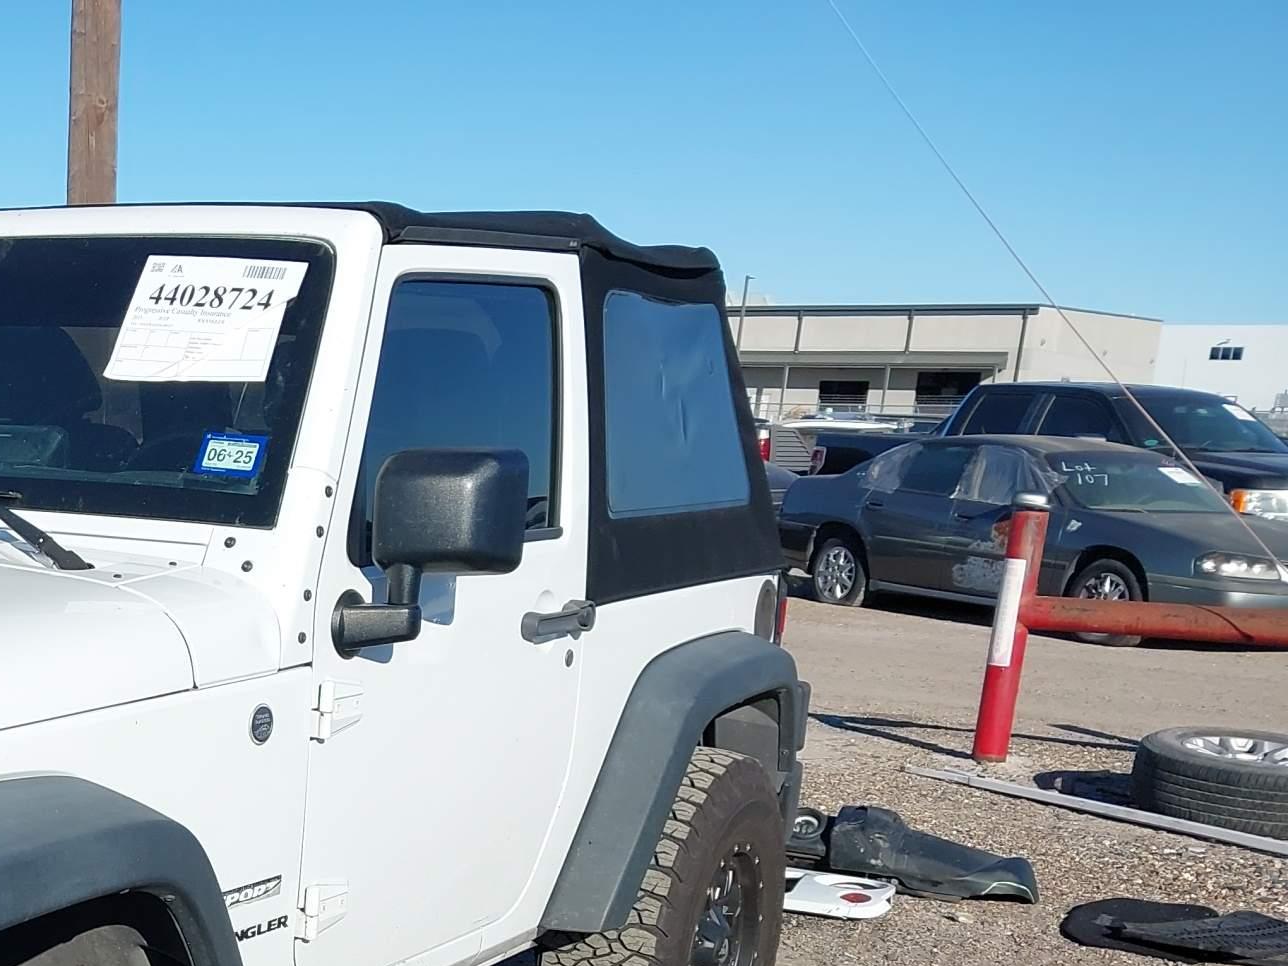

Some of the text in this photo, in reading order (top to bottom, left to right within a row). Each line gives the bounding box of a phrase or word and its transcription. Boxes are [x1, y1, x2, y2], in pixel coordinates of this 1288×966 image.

[149, 284, 275, 311] 44028724
[1061, 461, 1096, 472] Lot
[1076, 473, 1109, 487] 107
